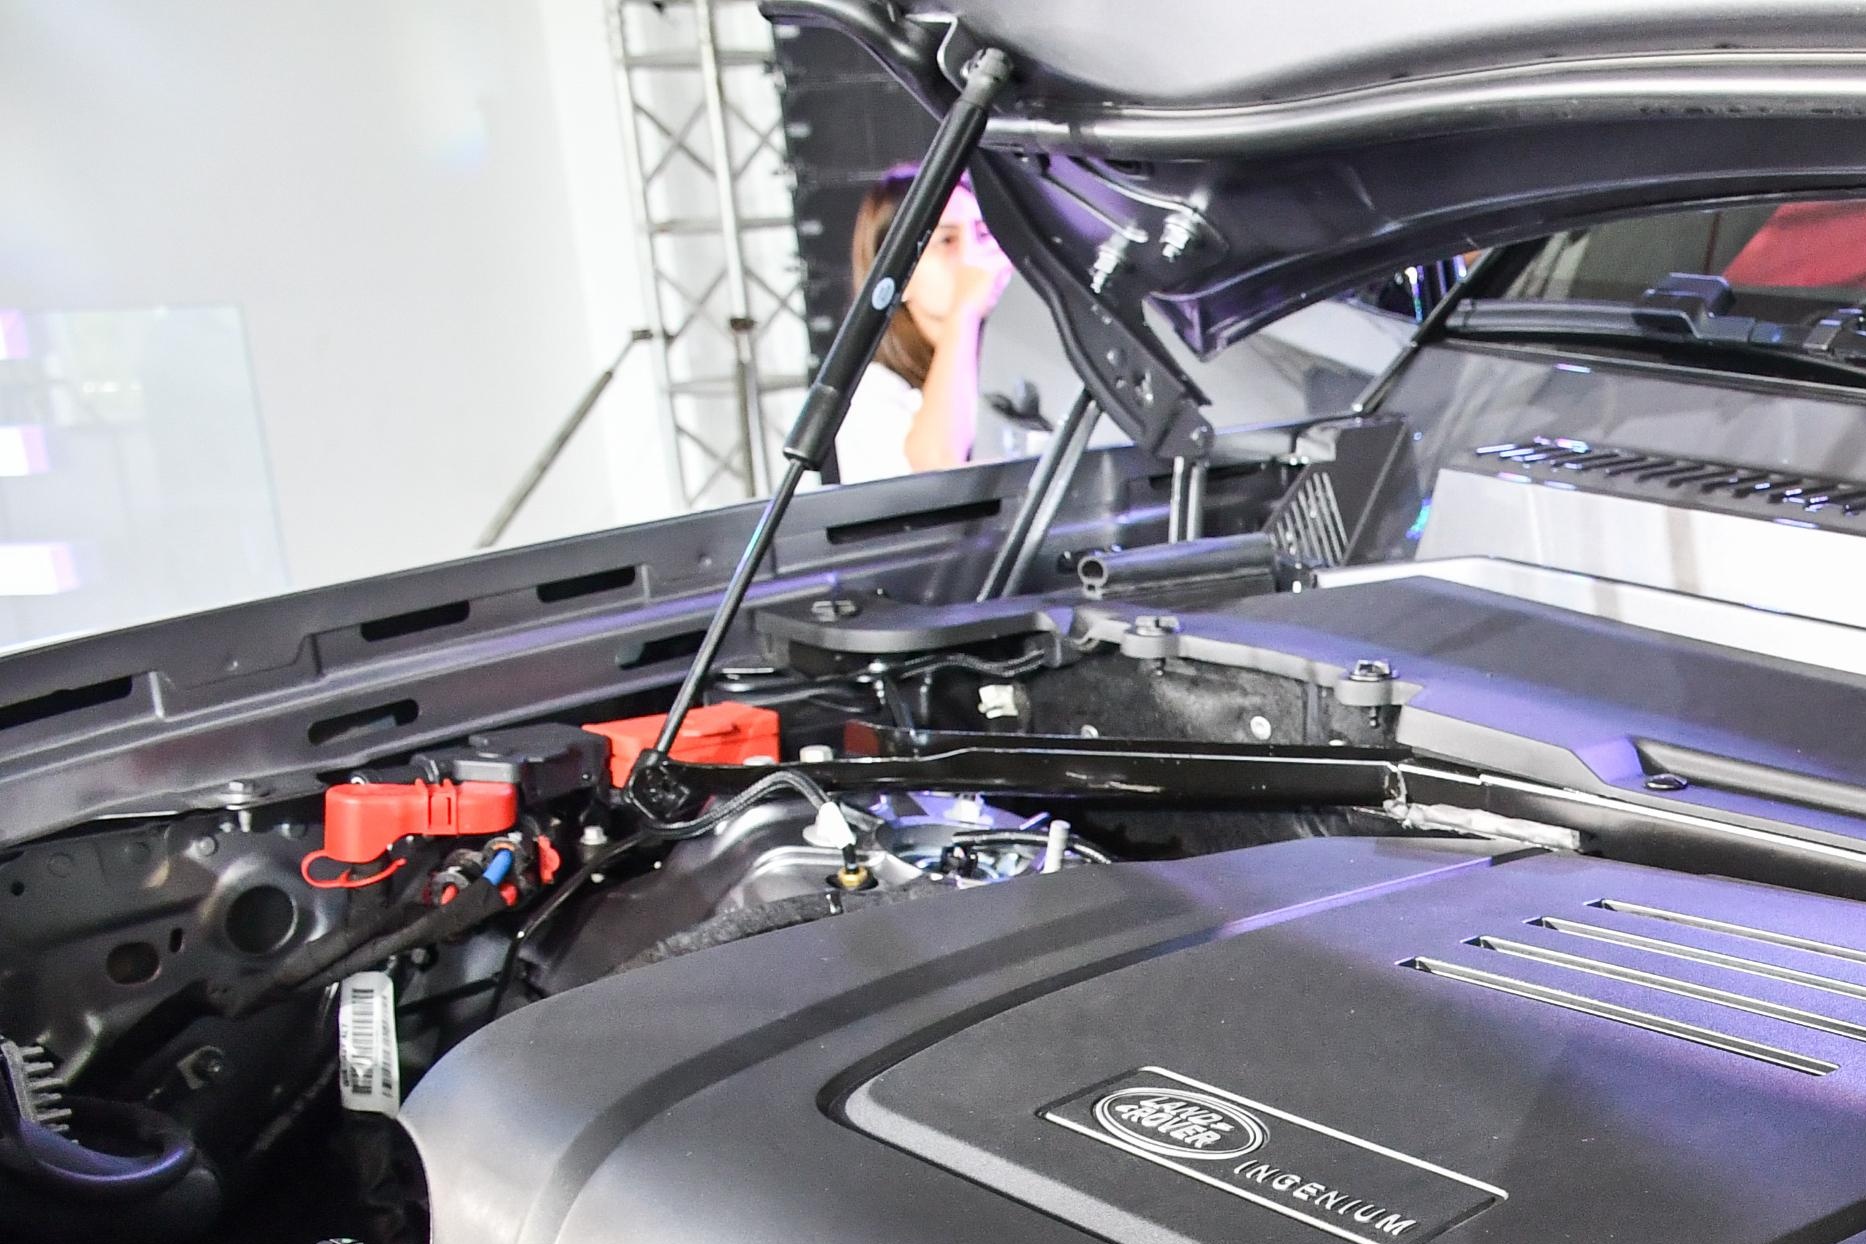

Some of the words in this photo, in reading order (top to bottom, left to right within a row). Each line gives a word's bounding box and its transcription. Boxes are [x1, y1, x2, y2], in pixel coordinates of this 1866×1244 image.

[1121, 1106, 1222, 1149] ROVER
[1139, 1096, 1225, 1126] LAND
[1233, 1159, 1417, 1236] INGENIUM
